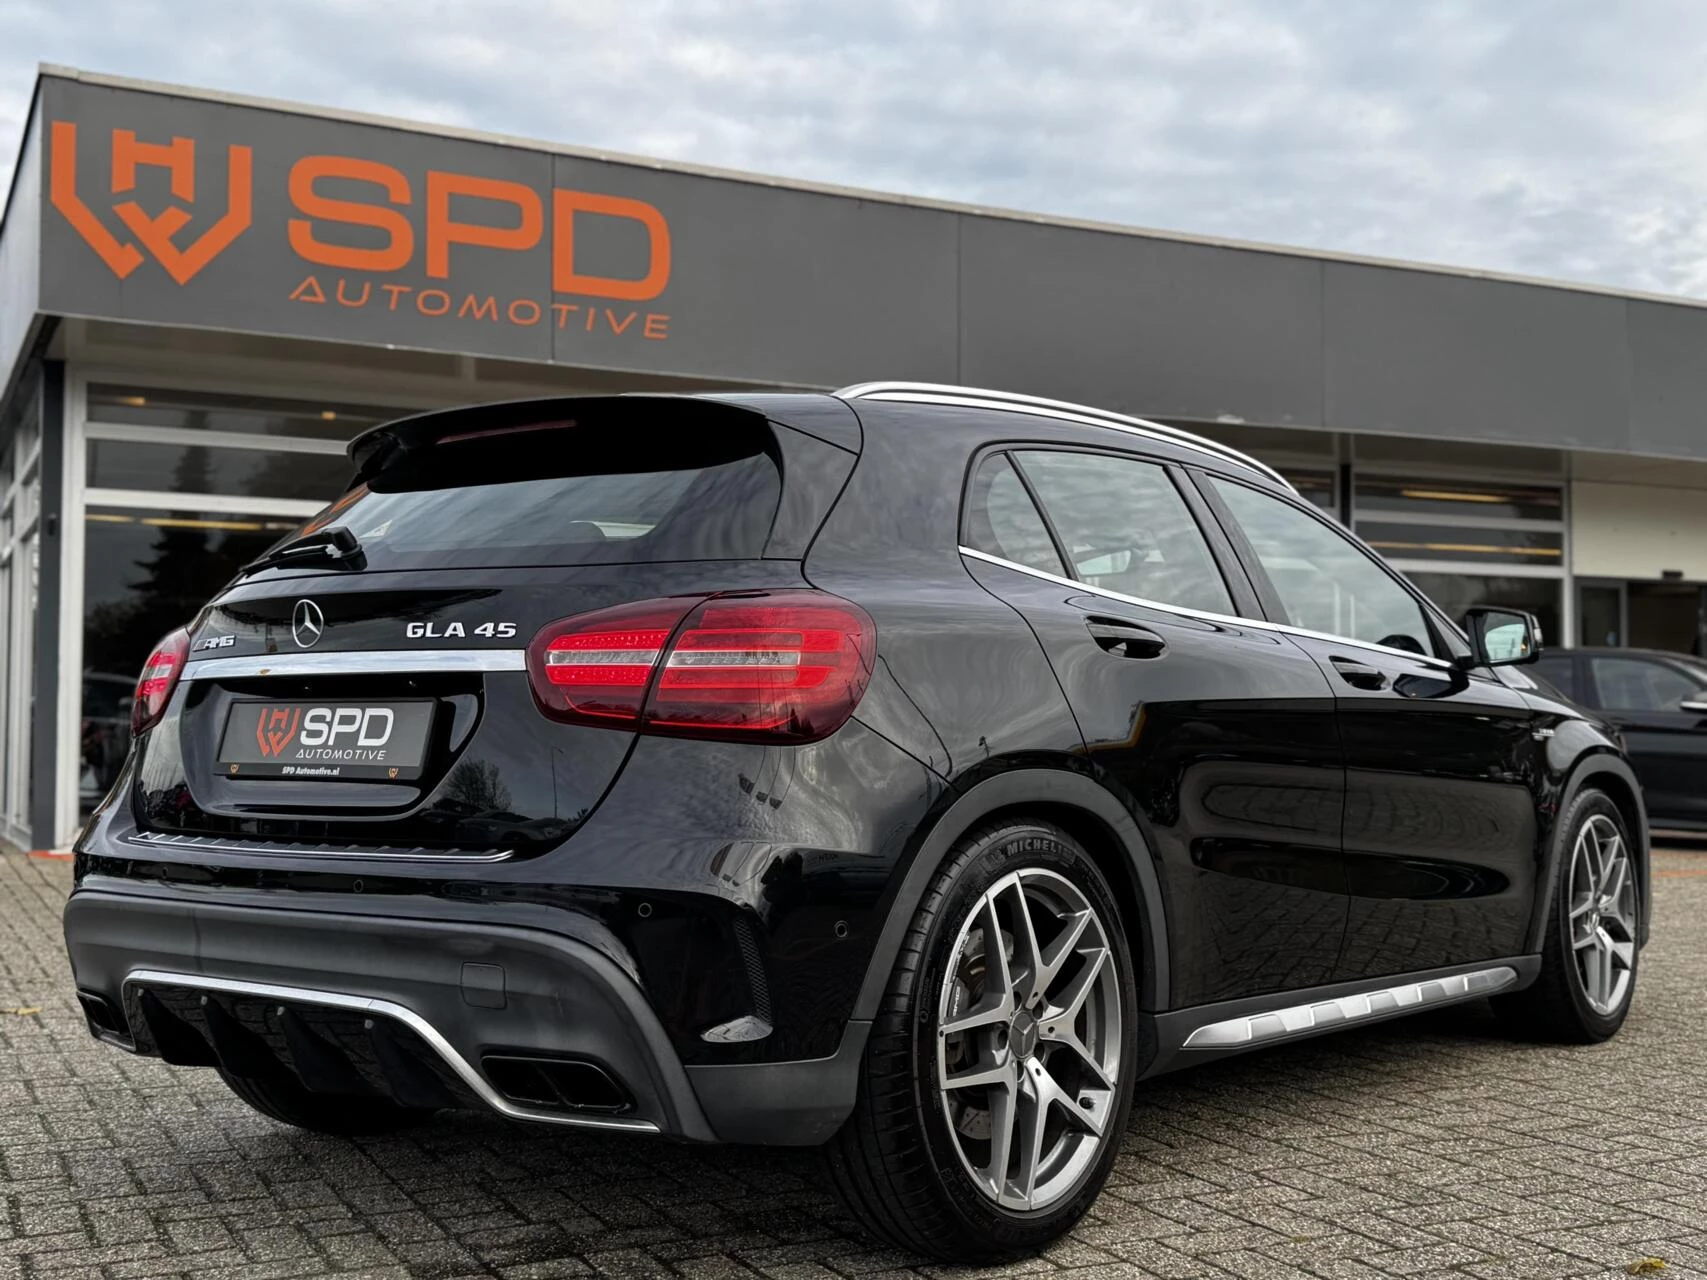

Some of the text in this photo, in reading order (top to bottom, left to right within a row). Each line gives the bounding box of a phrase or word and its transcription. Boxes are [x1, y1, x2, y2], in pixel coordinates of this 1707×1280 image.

[288, 155, 672, 301] SPD
[289, 275, 672, 340] AUTOMOTIVE
[406, 622, 518, 638] GLA 45
[300, 707, 395, 747] SPD
[295, 748, 387, 761] AUTOMOTIVE
[281, 766, 341, 776] SPD Automotive.nl
